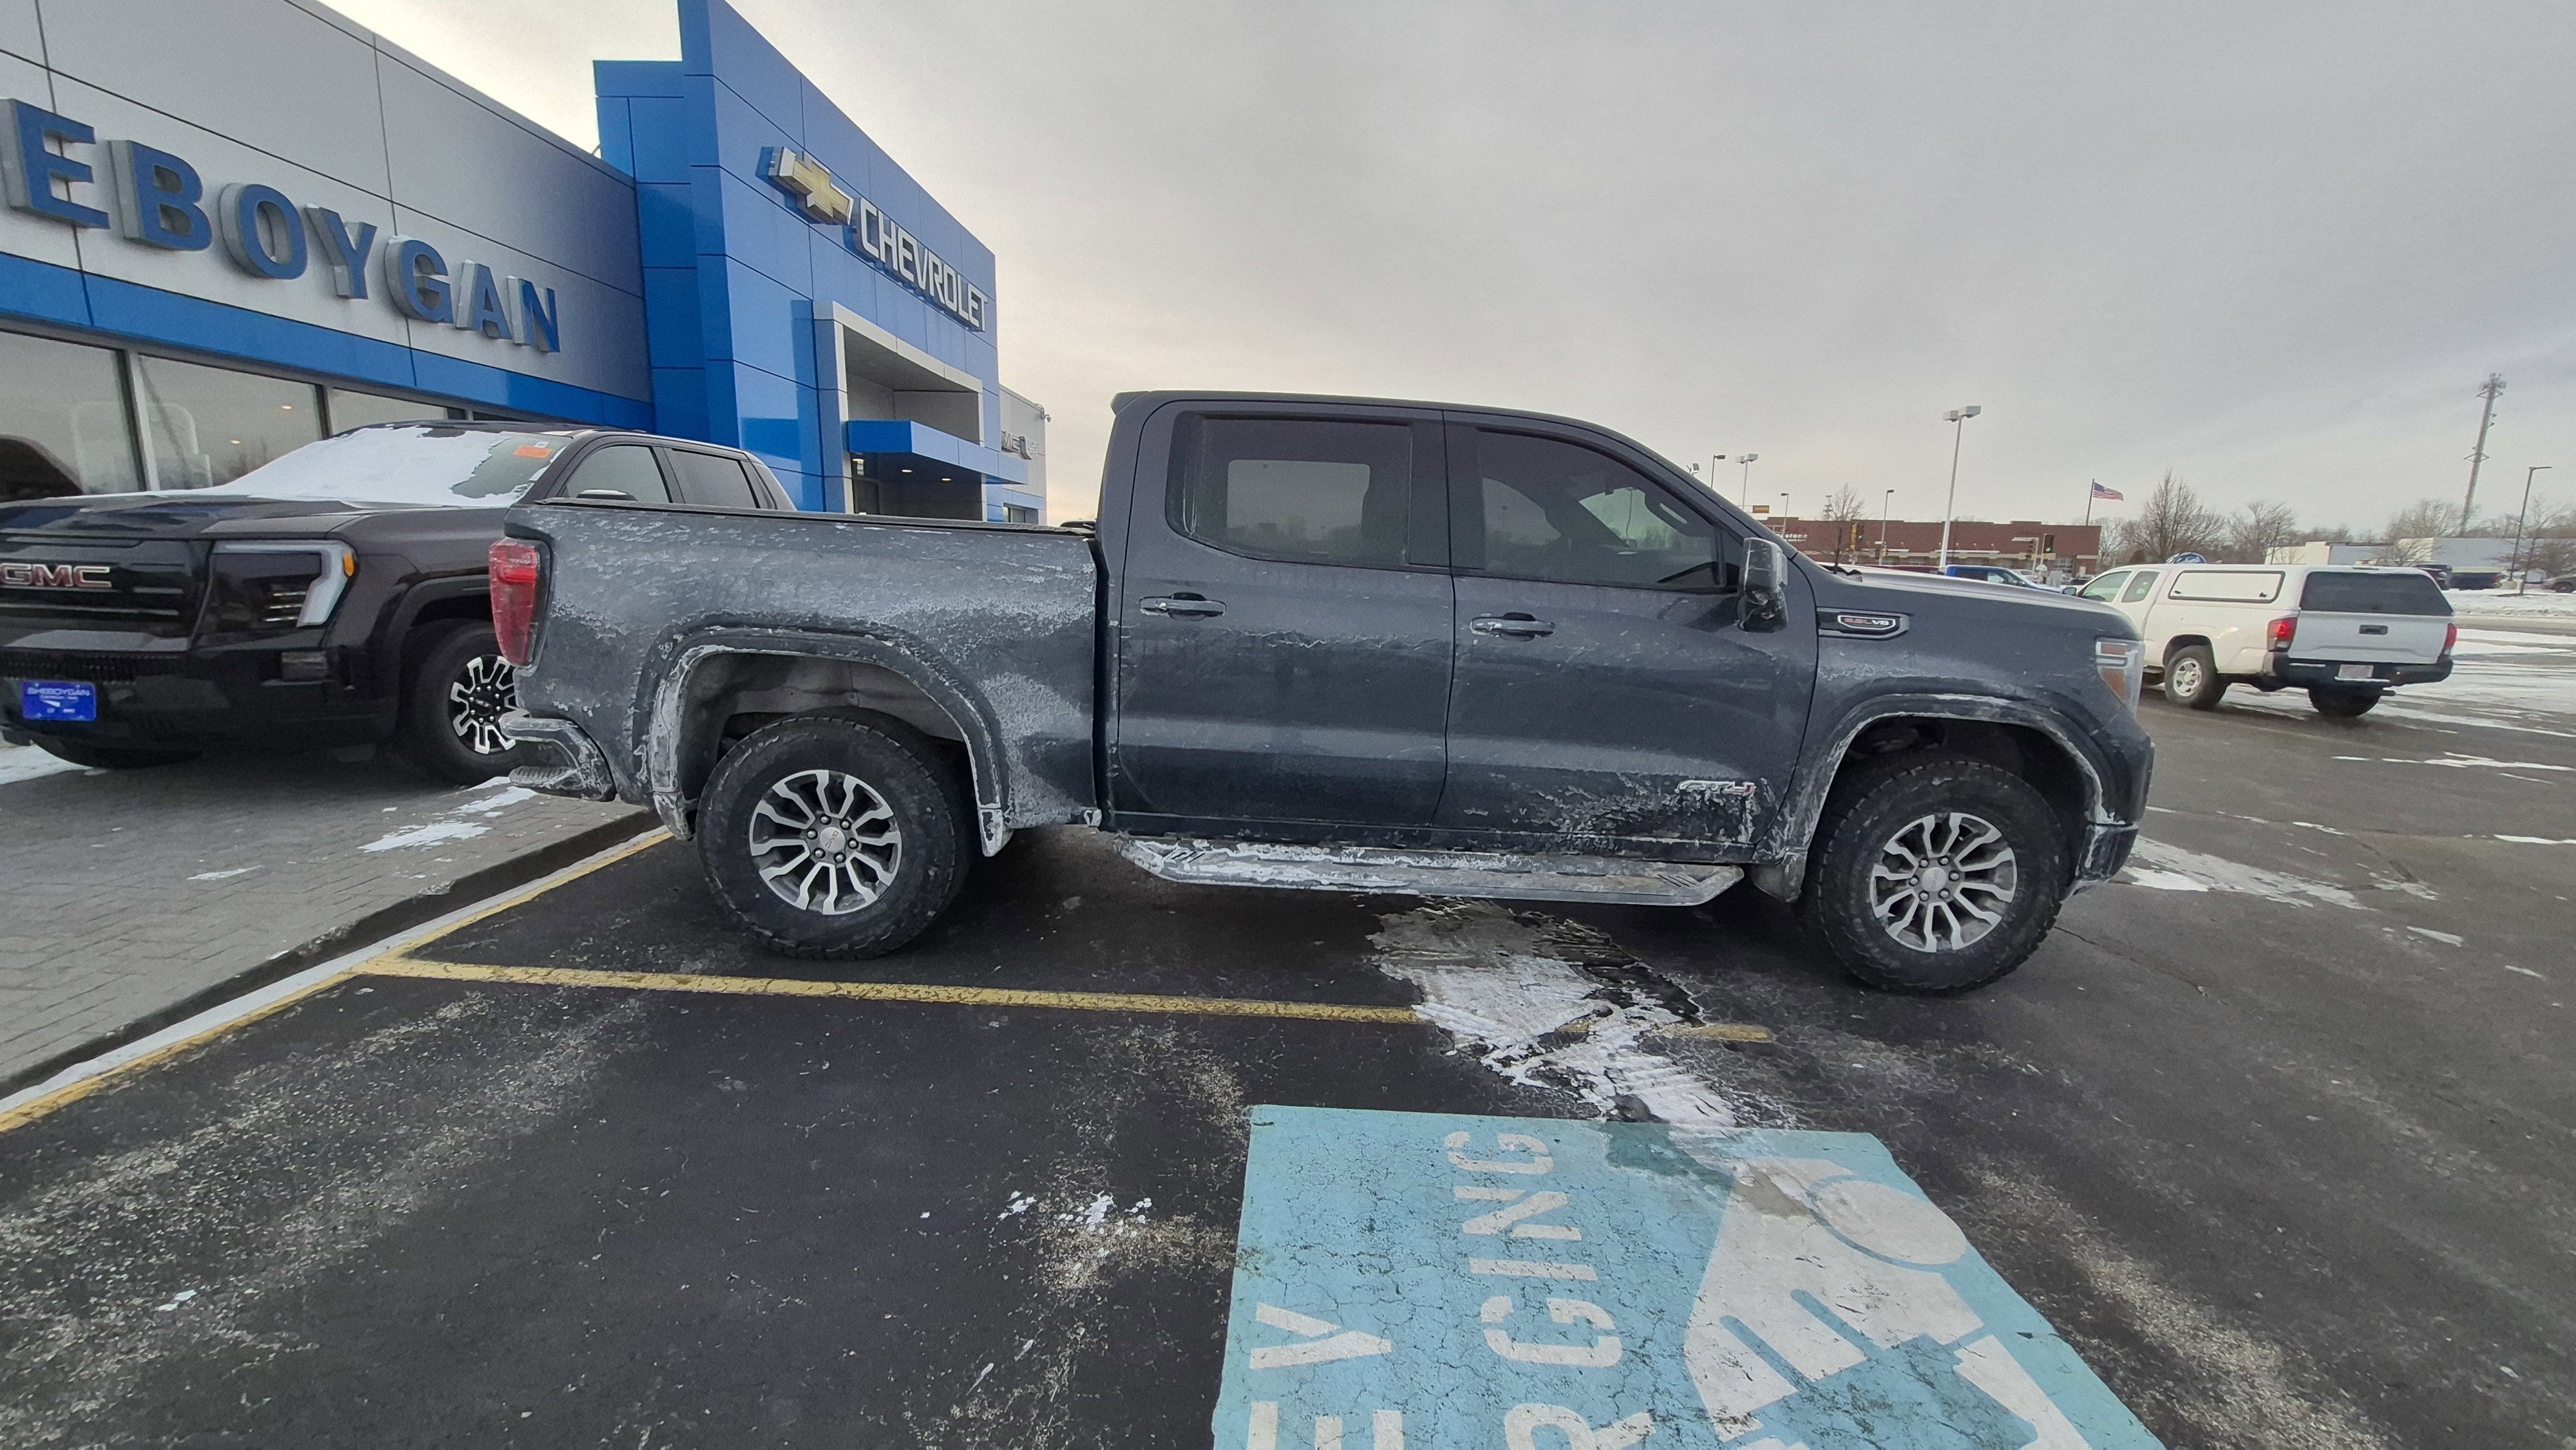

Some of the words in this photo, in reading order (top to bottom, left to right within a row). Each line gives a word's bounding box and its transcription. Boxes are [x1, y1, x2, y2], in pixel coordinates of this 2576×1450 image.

[2, 98, 560, 352] EBOYGAN
[860, 196, 988, 332] CHEVROLET
[0, 563, 112, 587] GMC
